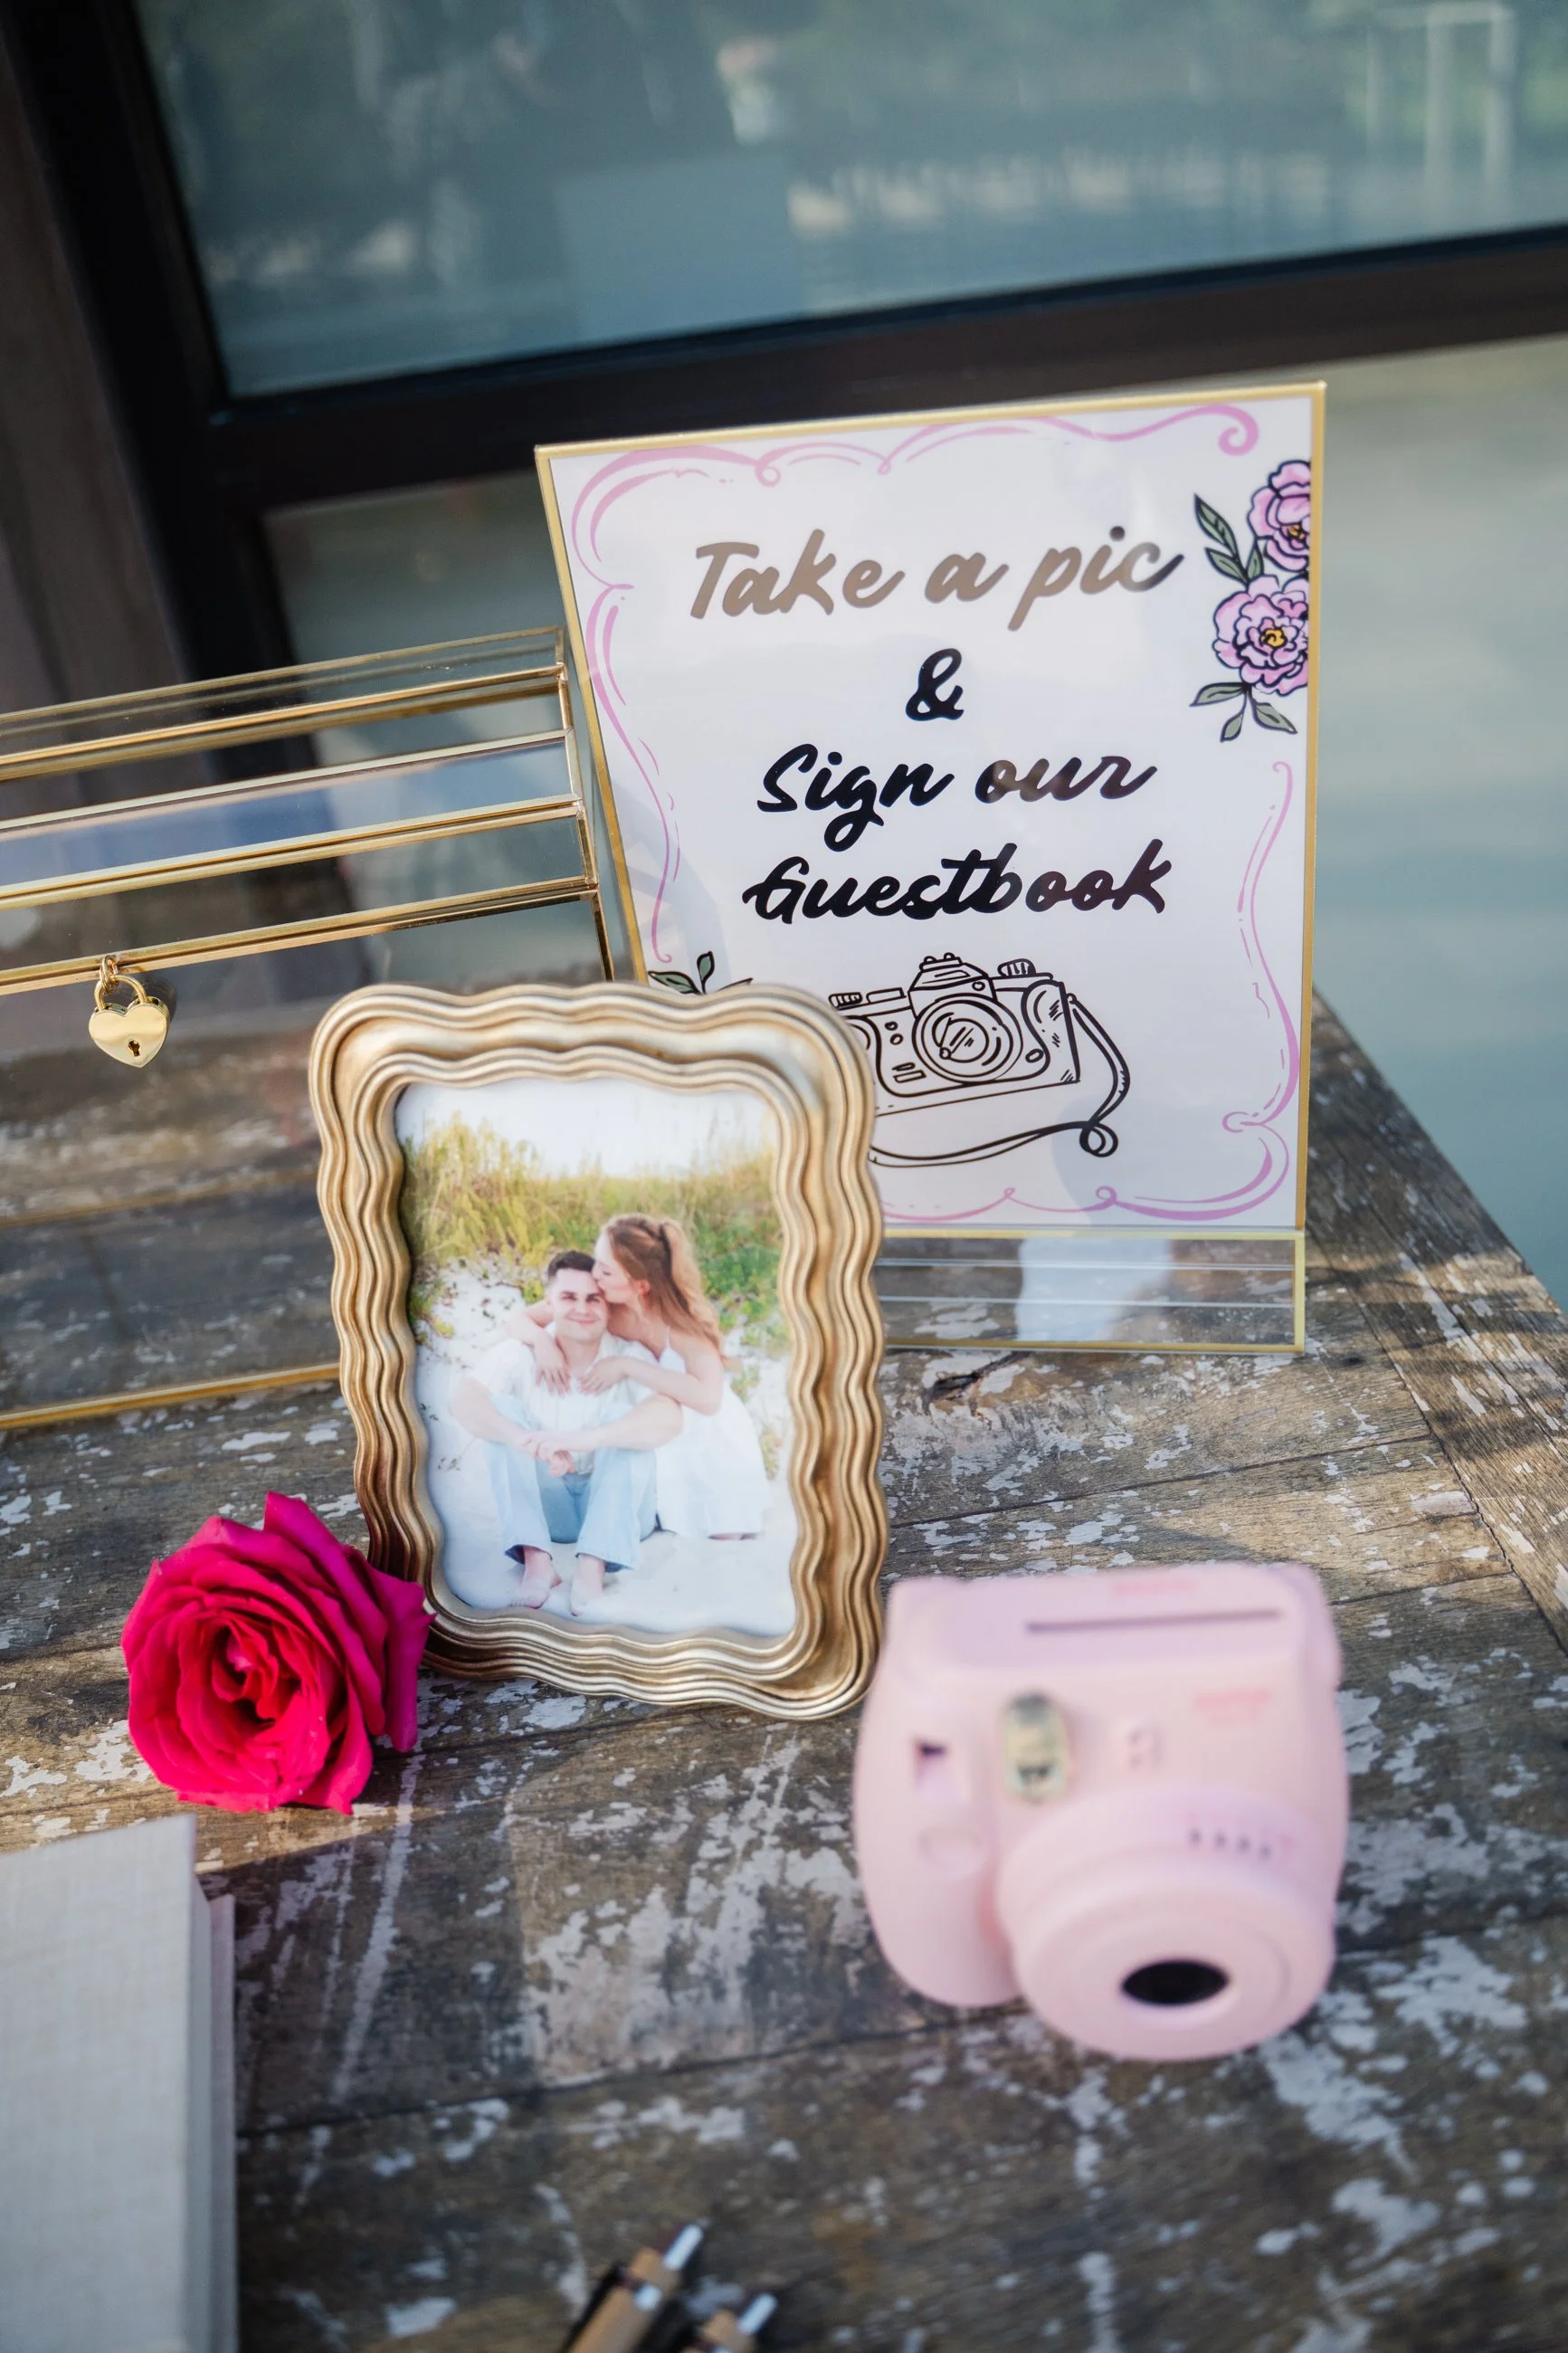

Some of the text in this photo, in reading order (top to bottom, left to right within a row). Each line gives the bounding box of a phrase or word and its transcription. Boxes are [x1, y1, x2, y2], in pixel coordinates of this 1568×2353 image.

[689, 525, 1185, 632] Take a pic
[905, 647, 965, 722] &
[755, 743, 1158, 853] Sign our
[741, 838, 1173, 925] Guestbook
